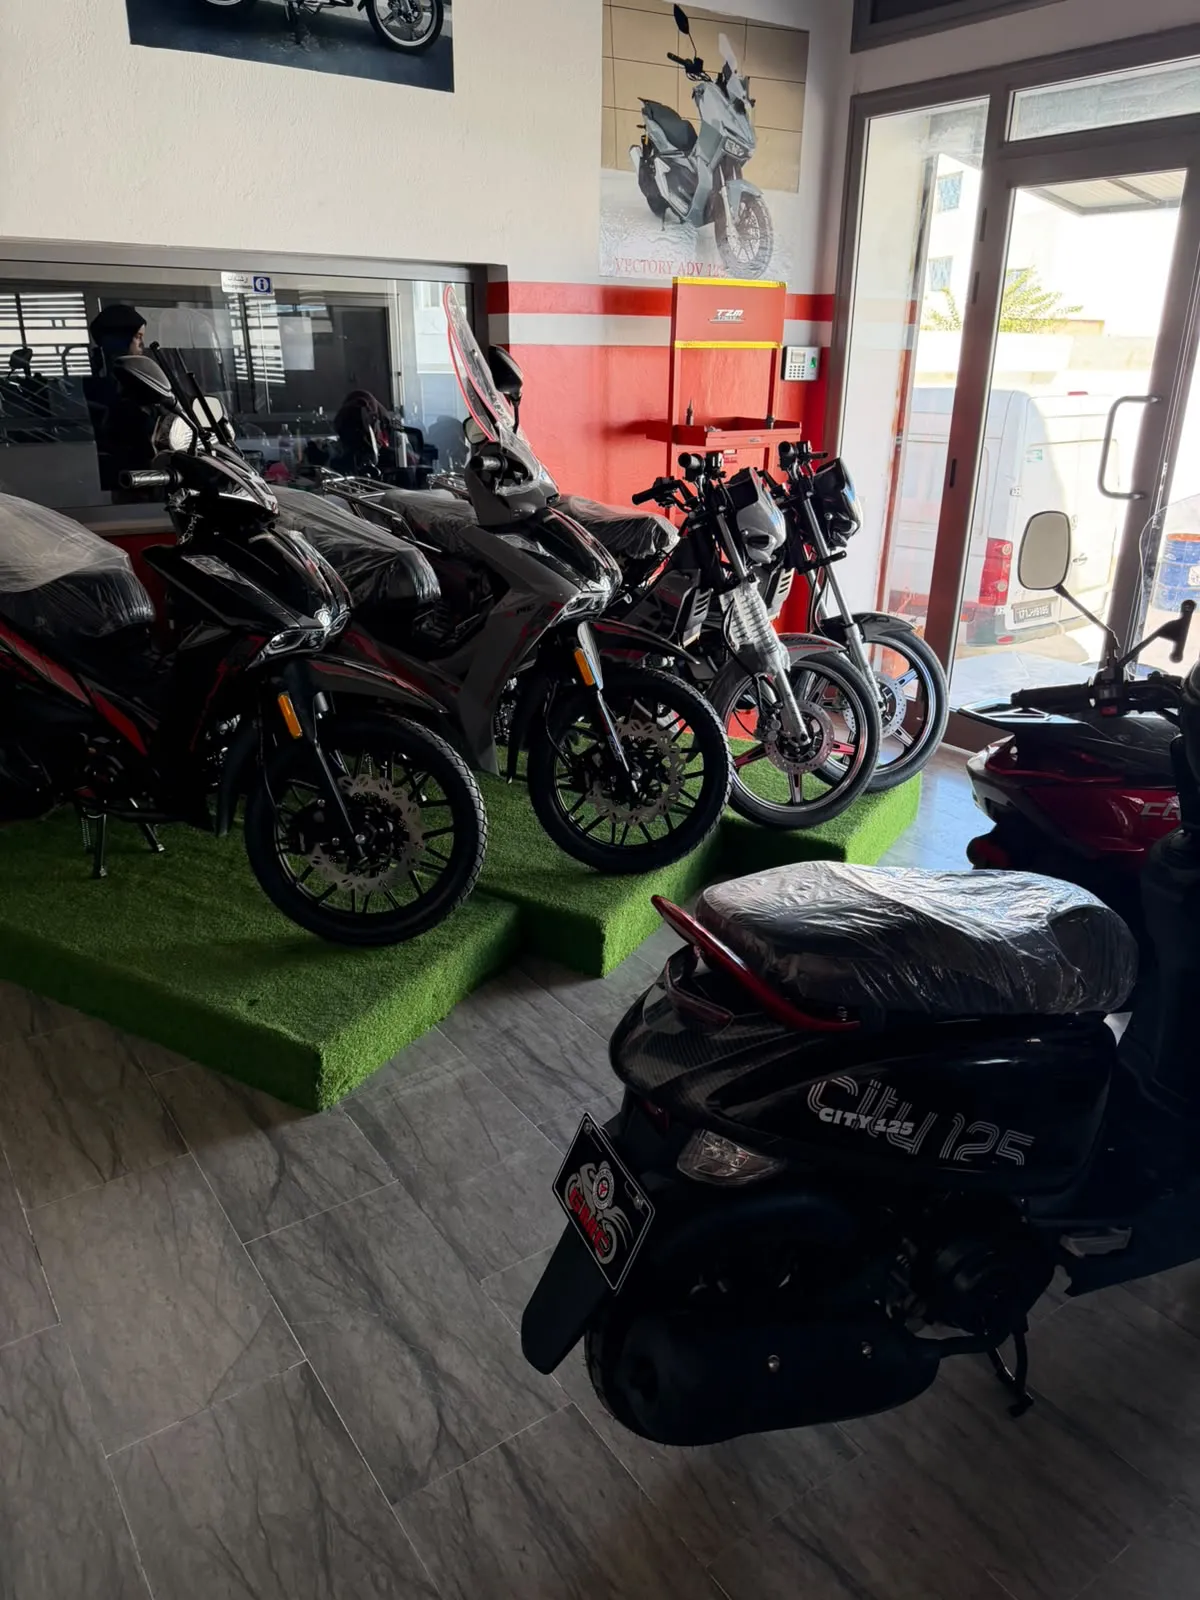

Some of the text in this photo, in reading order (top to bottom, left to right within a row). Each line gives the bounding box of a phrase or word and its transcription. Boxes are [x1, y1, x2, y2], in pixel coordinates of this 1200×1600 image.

[676, 260, 703, 276] ADV
[807, 1075, 1036, 1166] City 125
[818, 1107, 915, 1136] CITY 125
